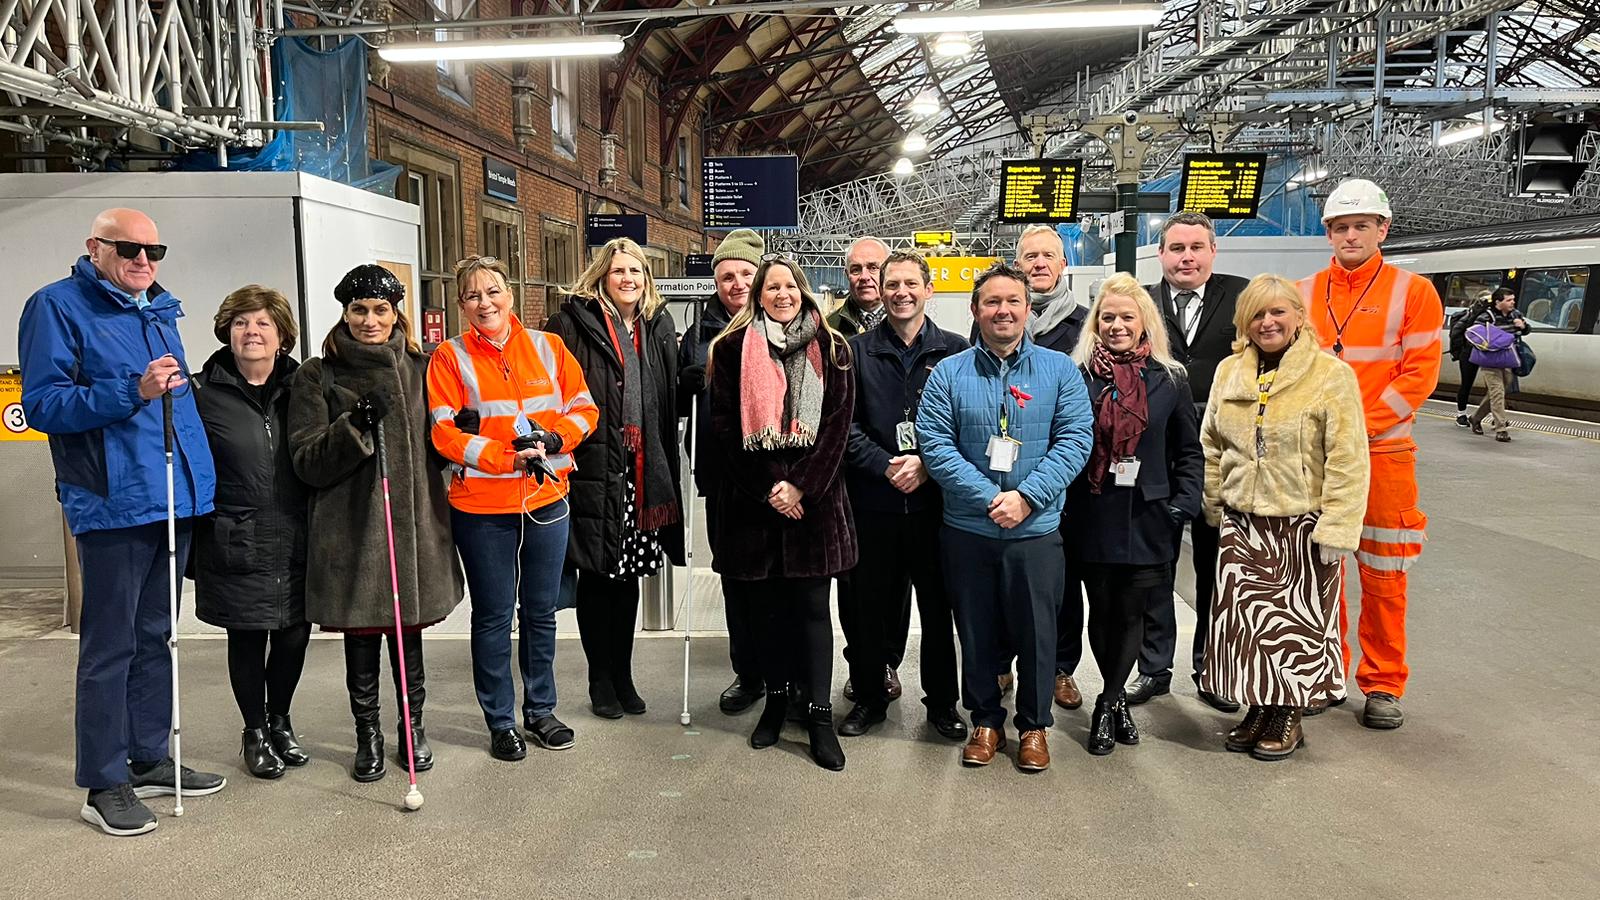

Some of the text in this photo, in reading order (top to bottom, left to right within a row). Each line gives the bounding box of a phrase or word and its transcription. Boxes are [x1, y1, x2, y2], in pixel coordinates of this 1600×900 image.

[930, 267, 985, 281] ER CR
[655, 282, 716, 291] ormation Poin
[11, 408, 24, 427] 3
